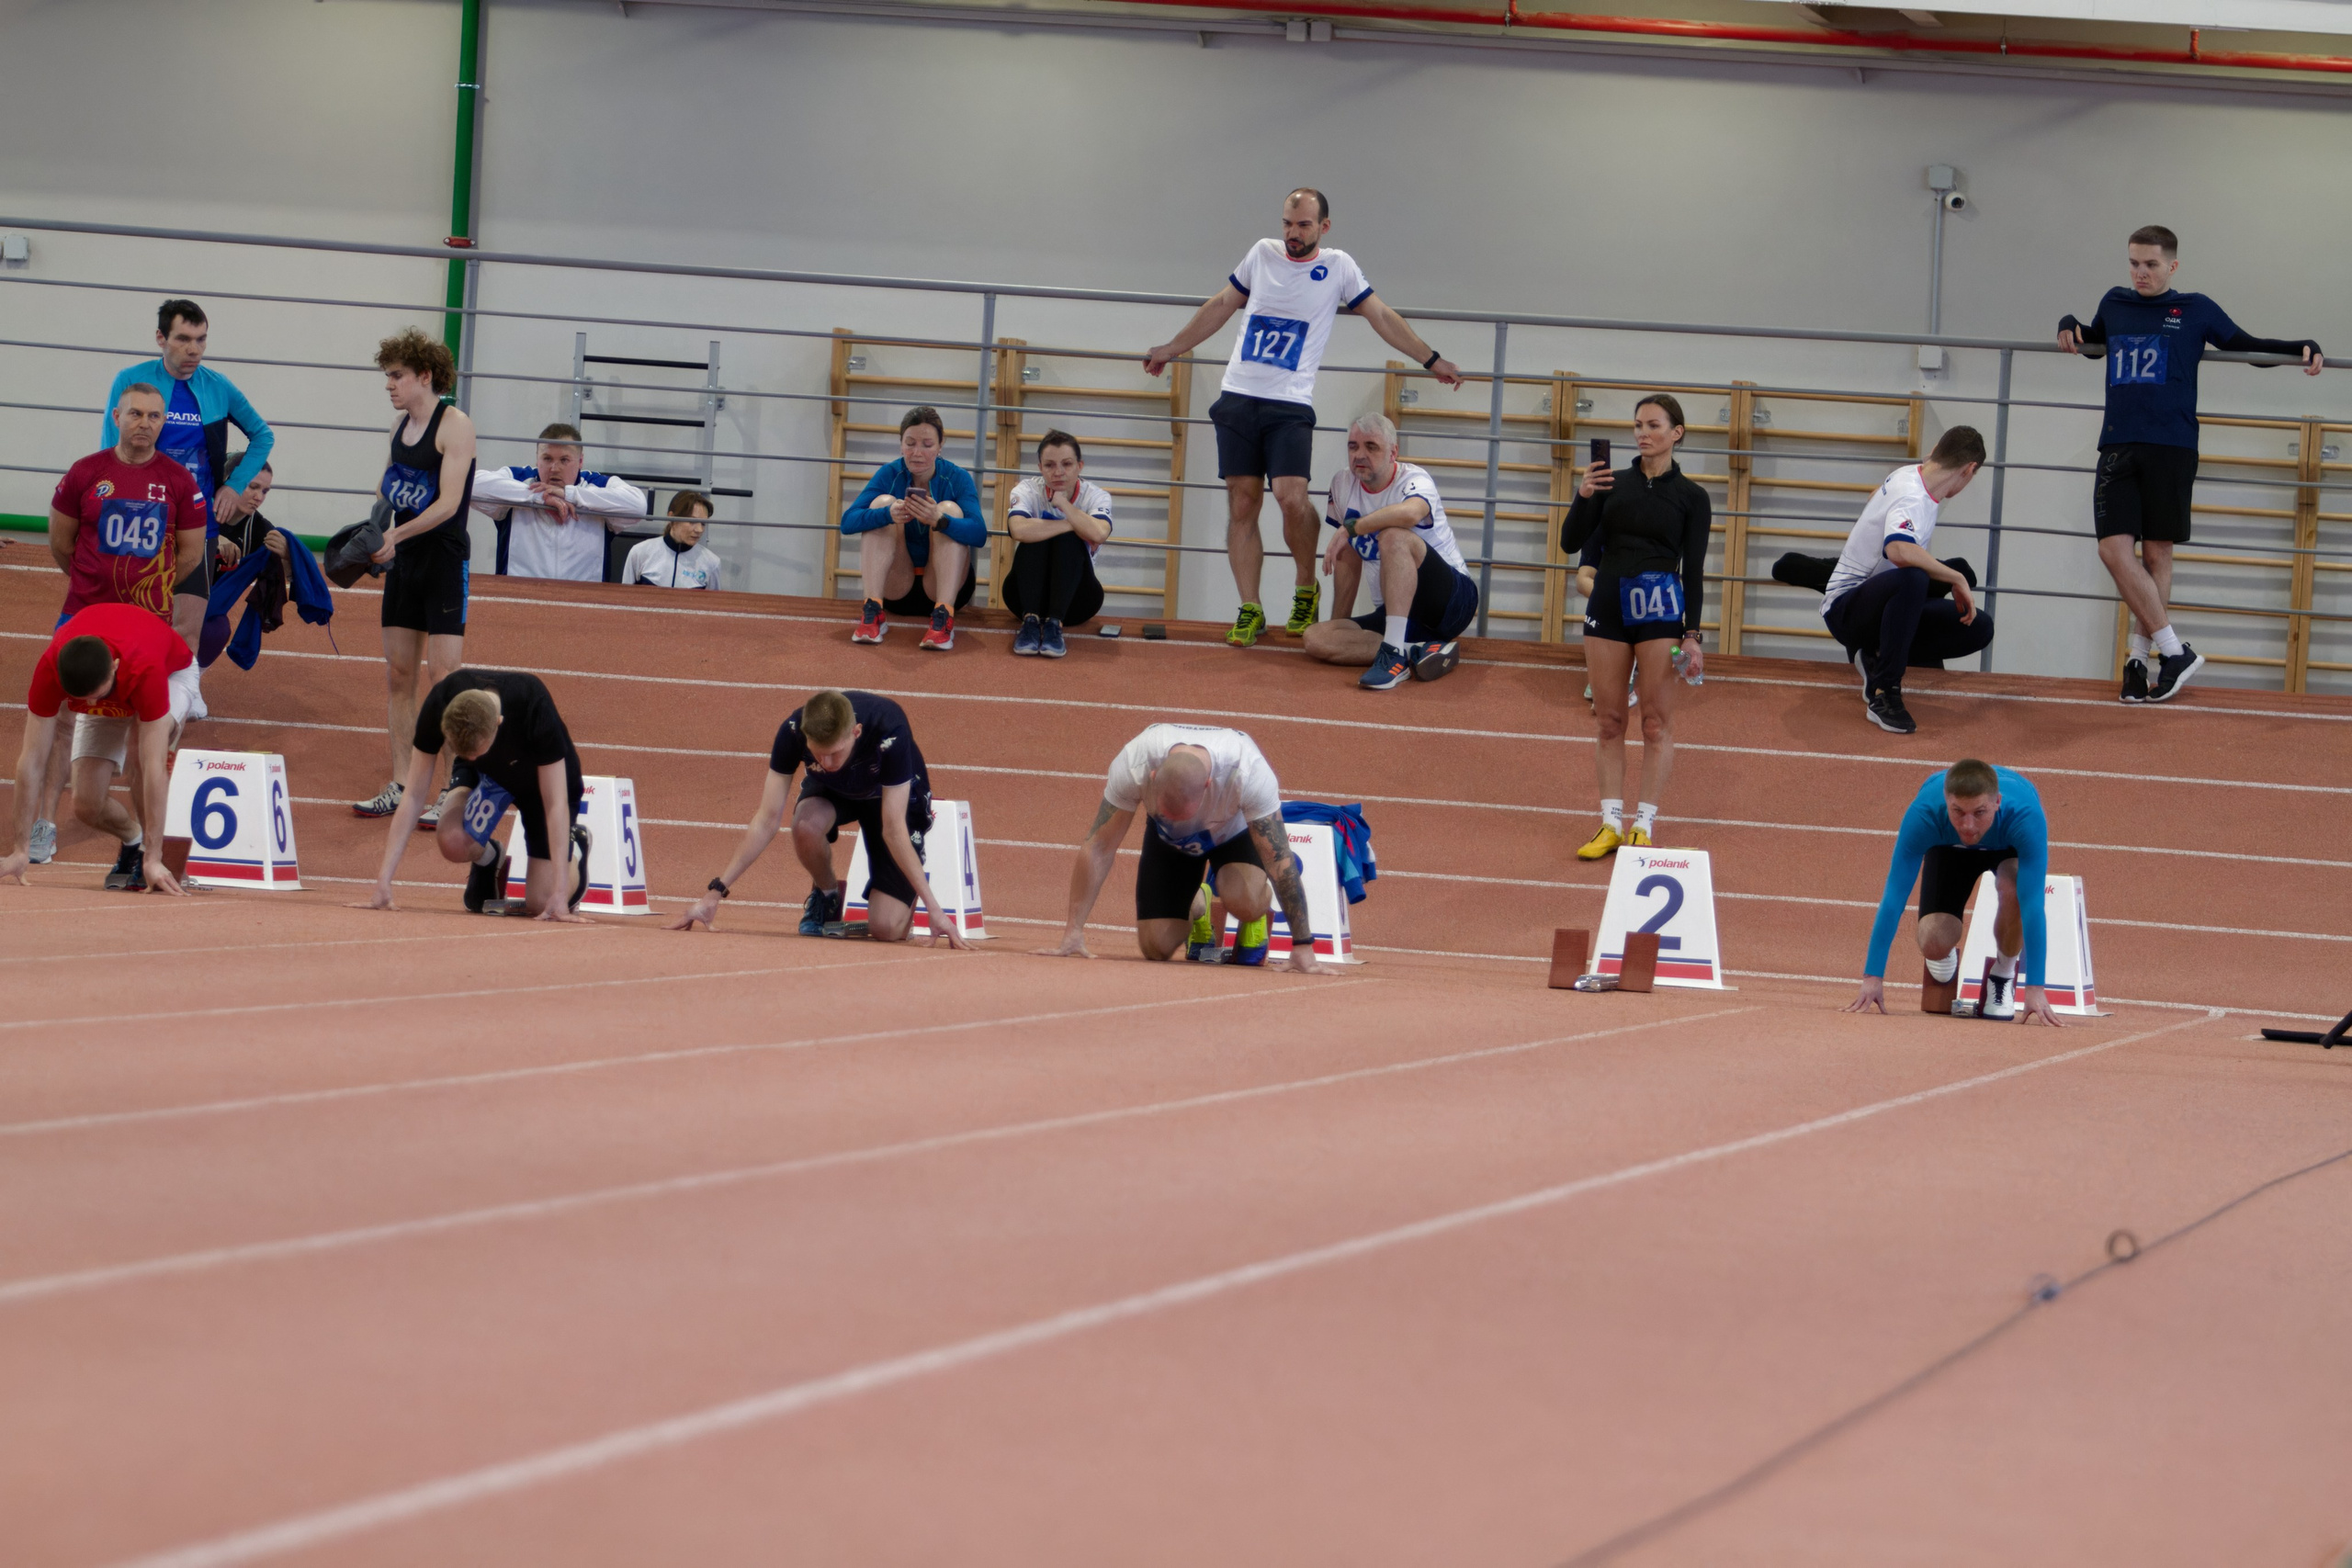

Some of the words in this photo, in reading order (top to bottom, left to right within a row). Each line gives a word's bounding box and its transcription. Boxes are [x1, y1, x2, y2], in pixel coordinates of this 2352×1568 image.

[1252, 329, 1297, 360] 127
[2115, 348, 2157, 378] 112
[389, 479, 428, 510] 150
[106, 513, 160, 551] 043
[1629, 583, 1680, 620] 041
[206, 761, 247, 772] polanik
[190, 775, 240, 851] 6
[272, 779, 287, 854] 6
[464, 784, 495, 833] 38
[621, 803, 637, 879] 5
[1287, 833, 1313, 844] lanik
[964, 826, 975, 901] 4
[1648, 858, 1690, 870] polanik
[1634, 874, 1685, 951] 2
